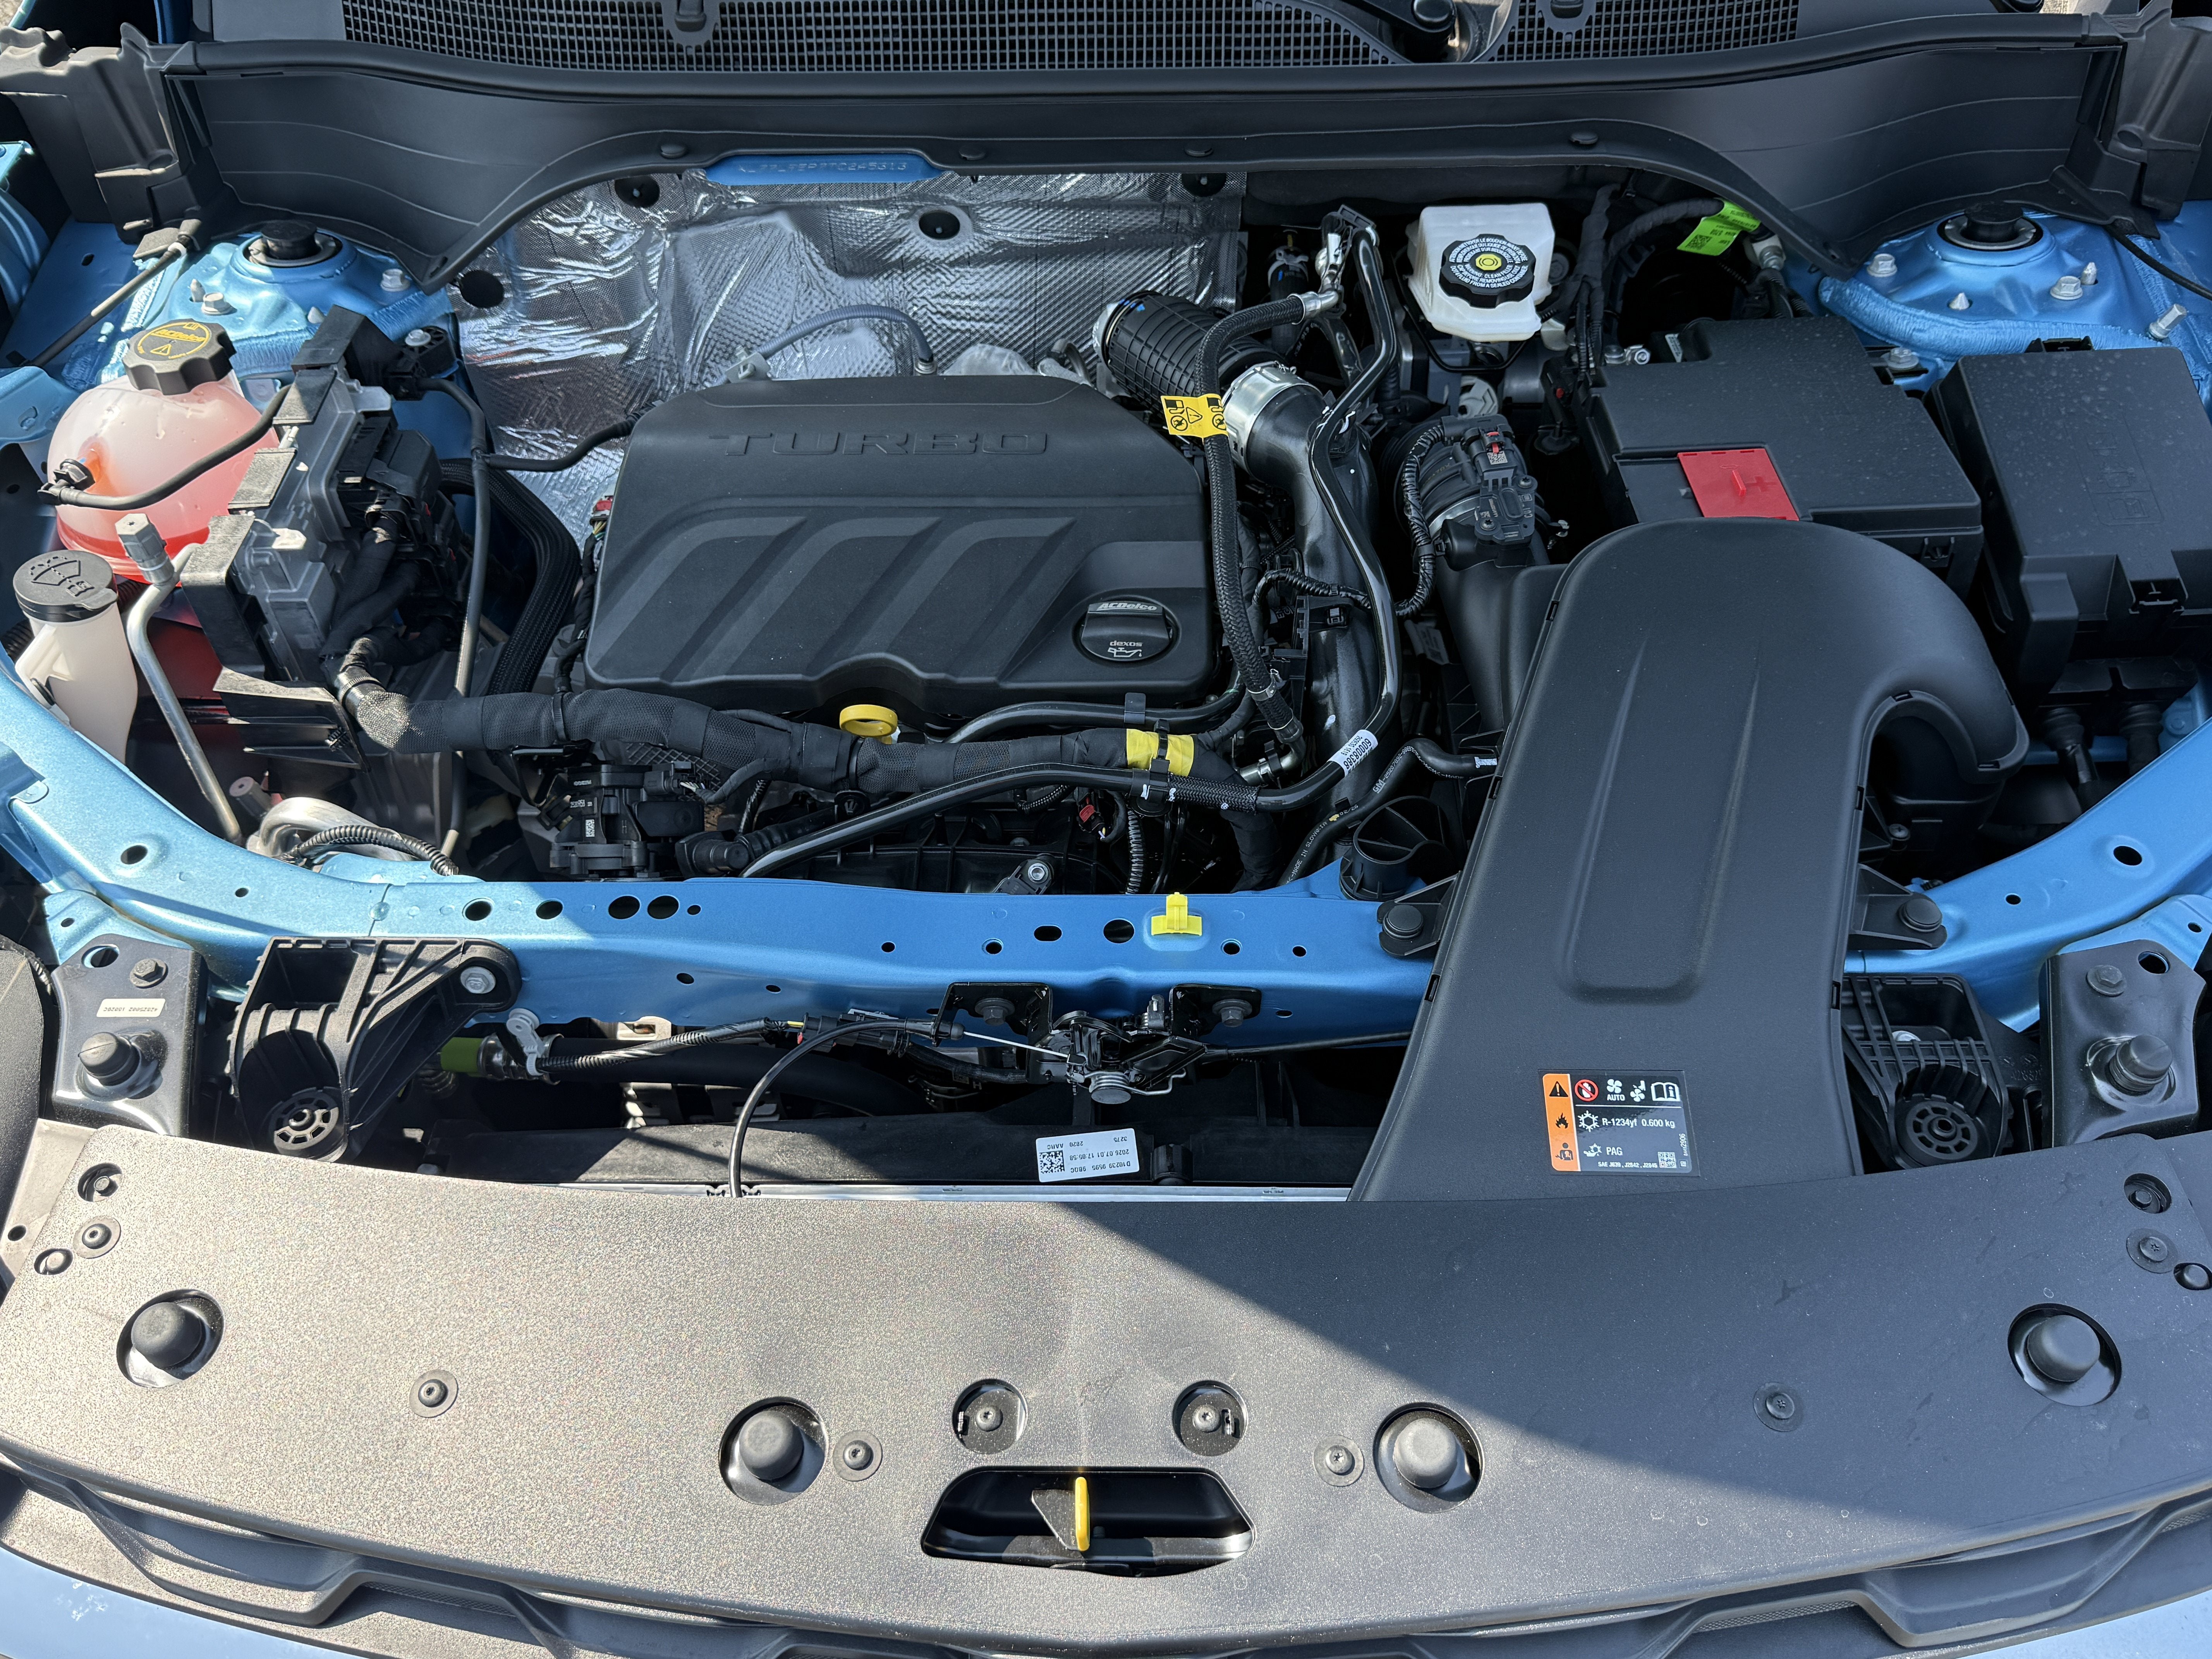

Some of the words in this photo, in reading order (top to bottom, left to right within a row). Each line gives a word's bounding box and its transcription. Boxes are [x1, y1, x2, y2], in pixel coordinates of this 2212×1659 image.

[709, 432, 1047, 456] TURBO
[1096, 602, 1158, 611] ACDelco
[1343, 738, 1372, 769] 60008388
[1305, 822, 1328, 848] SLOVAKIA
[1602, 1118, 1637, 1127] R-1234yf
[1641, 1119, 1663, 1127] 0.600
[1665, 1119, 1675, 1128] kg
[1097, 1149, 1130, 1158] 2026.07.01
[1606, 1147, 1623, 1156] PAG
